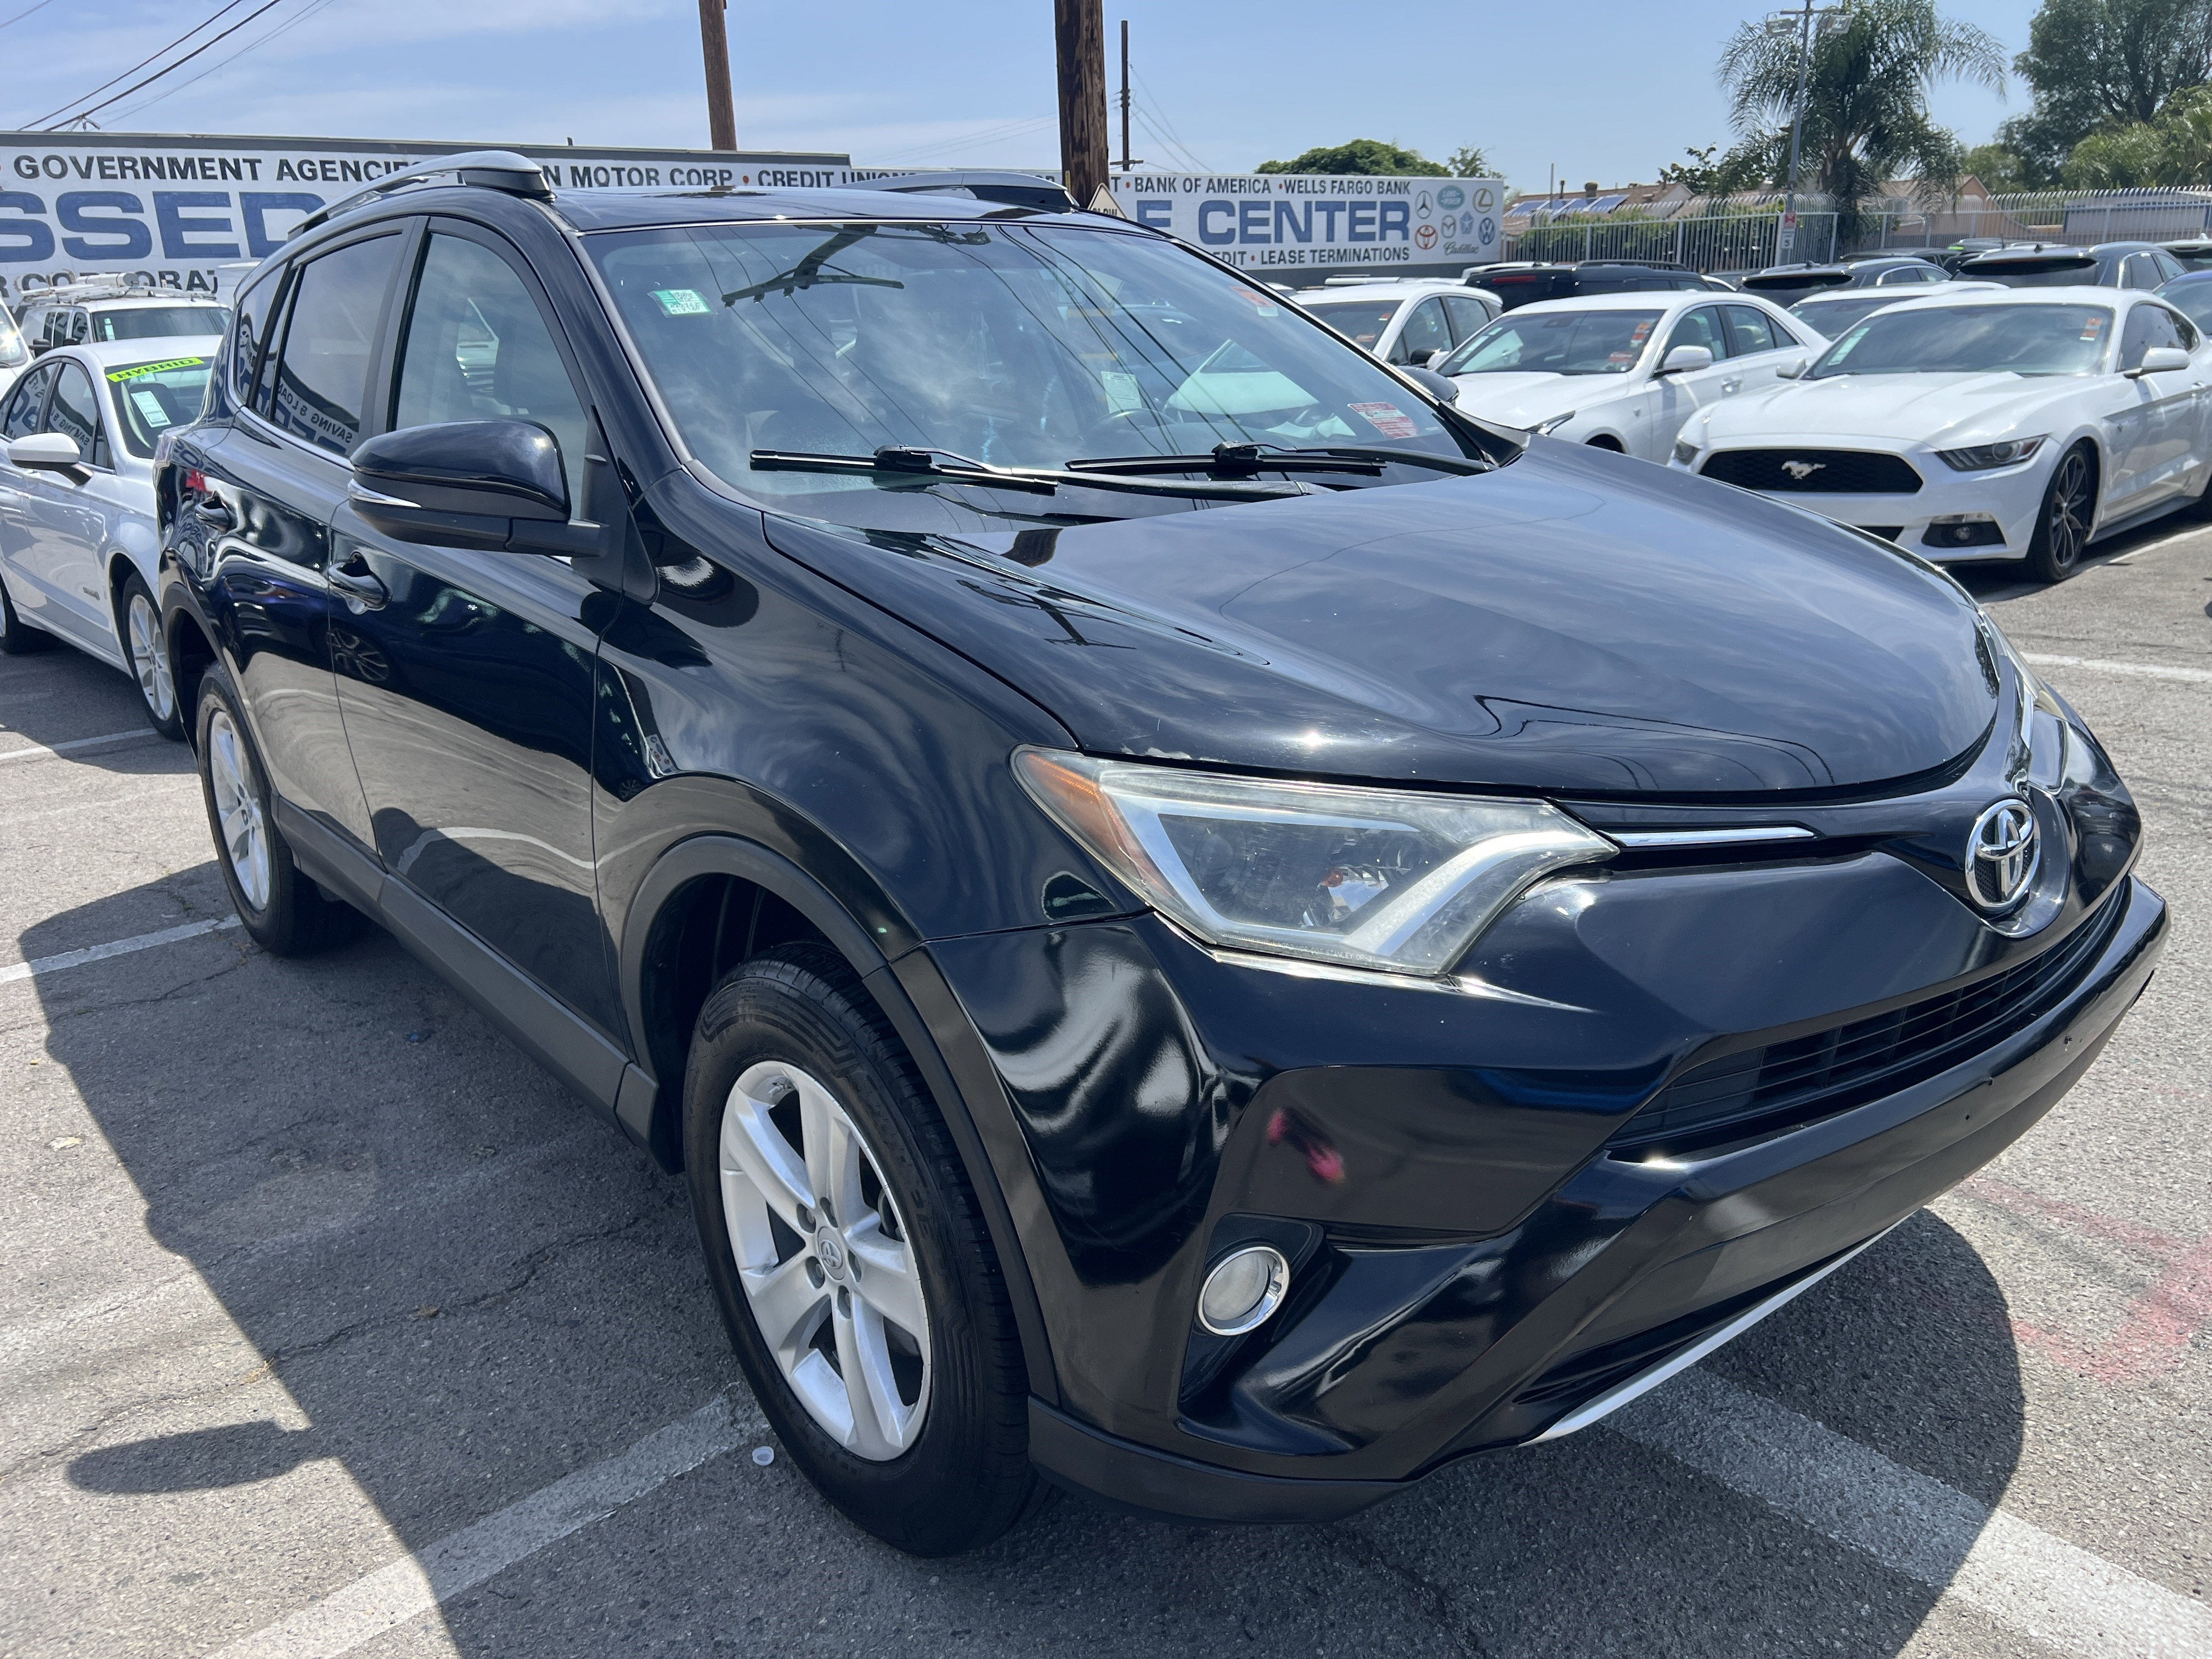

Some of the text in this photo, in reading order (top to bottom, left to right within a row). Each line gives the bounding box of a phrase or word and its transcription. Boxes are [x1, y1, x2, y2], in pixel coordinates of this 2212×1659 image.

[14, 155, 422, 182] GOVERNMENT AGENCI
[571, 166, 659, 188] MOTOR
[670, 168, 732, 186] CORP
[758, 170, 834, 188] CREDIT
[1135, 177, 1271, 193] BANK OF AMERICA
[1284, 179, 1411, 194] WELLS FARGO BANK
[1199, 200, 1410, 245] CENTER
[1261, 247, 1410, 264] LEASE TERMINATIONS
[116, 359, 195, 379] HYBRID
